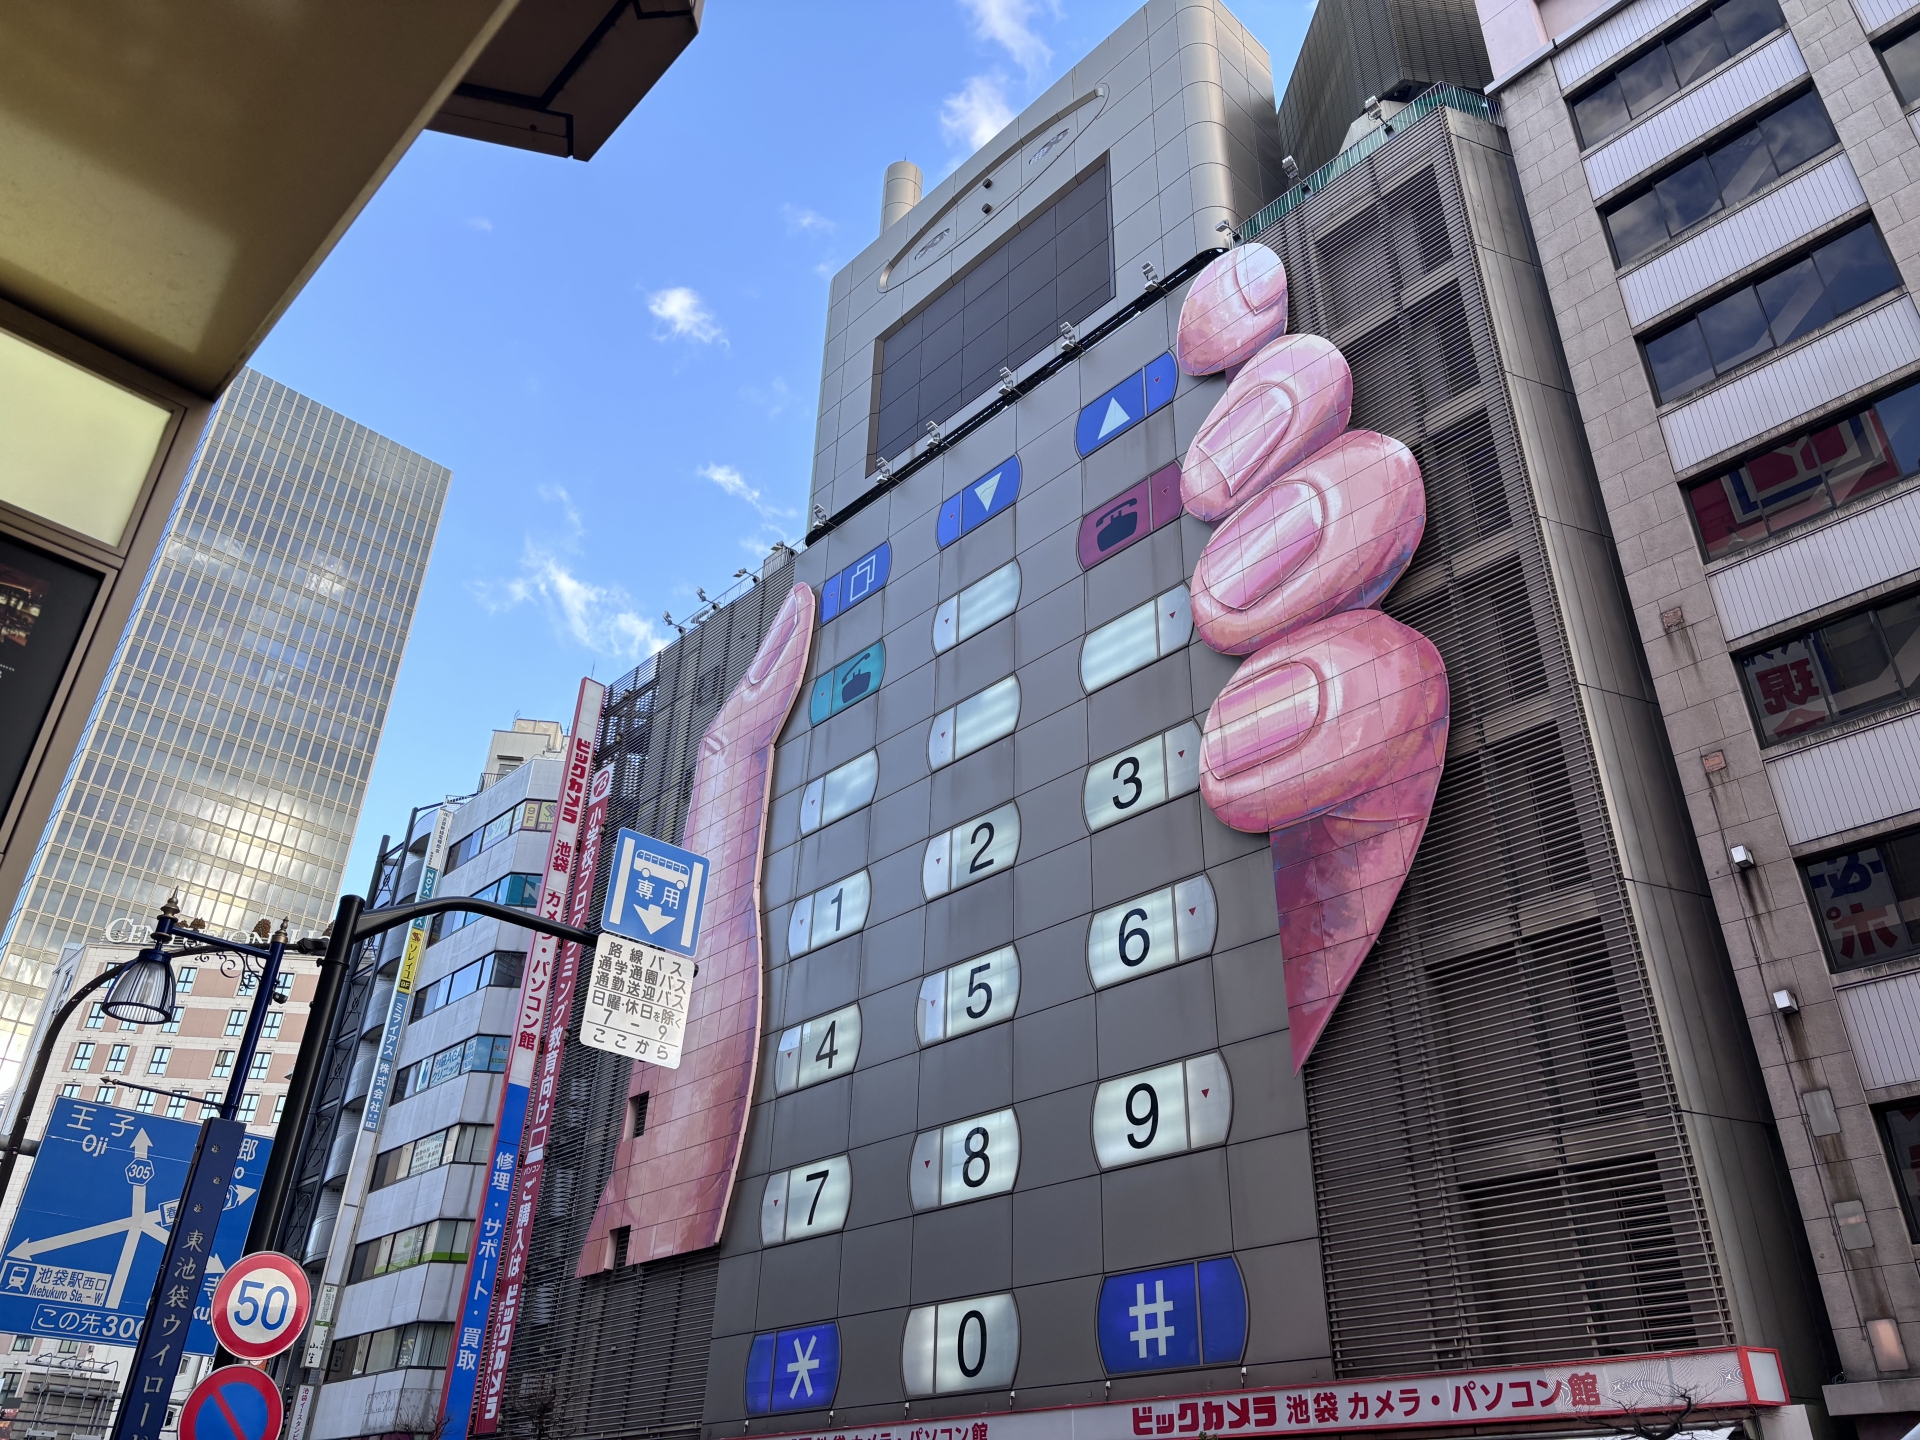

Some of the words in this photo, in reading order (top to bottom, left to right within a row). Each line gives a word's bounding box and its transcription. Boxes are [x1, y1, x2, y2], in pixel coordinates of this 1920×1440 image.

[562, 737, 591, 824] ビックカメラ
[1112, 757, 1143, 810] 3
[553, 840, 573, 874] 池袋
[969, 822, 995, 874] 2
[421, 872, 434, 896] NOVA
[635, 878, 681, 910] 専用
[830, 887, 844, 932] 1
[609, 941, 682, 978] 路線バス
[1118, 908, 1150, 967] 6
[518, 892, 561, 1052] カメ・パソコン館
[595, 971, 685, 1011] 通勤送迎バス
[598, 954, 687, 995] 通学通園バス
[966, 962, 993, 1019] 5
[593, 1027, 669, 1061] ここから
[603, 1008, 613, 1026] 7
[658, 1025, 668, 1042] 9
[815, 1020, 839, 1070] 4
[369, 1062, 390, 1113] 株式会社
[66, 1104, 135, 1137] 王子
[1125, 1083, 1159, 1149] 9
[82, 1134, 109, 1157] Oji
[962, 1127, 990, 1188] 8
[128, 1164, 151, 1180] 305
[523, 1164, 541, 1176] パソコン
[806, 1169, 829, 1226] 7
[508, 1176, 537, 1279] ご購入は
[29, 1284, 68, 1300] Ikebukuro
[36, 1267, 108, 1292] 池袋駅西口
[37, 1307, 145, 1340] この先300
[233, 1280, 290, 1331] 50
[957, 1310, 988, 1378] 0
[1132, 1396, 1277, 1436] ビックカメラ
[1286, 1391, 1339, 1425] 池袋
[1348, 1371, 1602, 1421] カメラ・パソコン館
